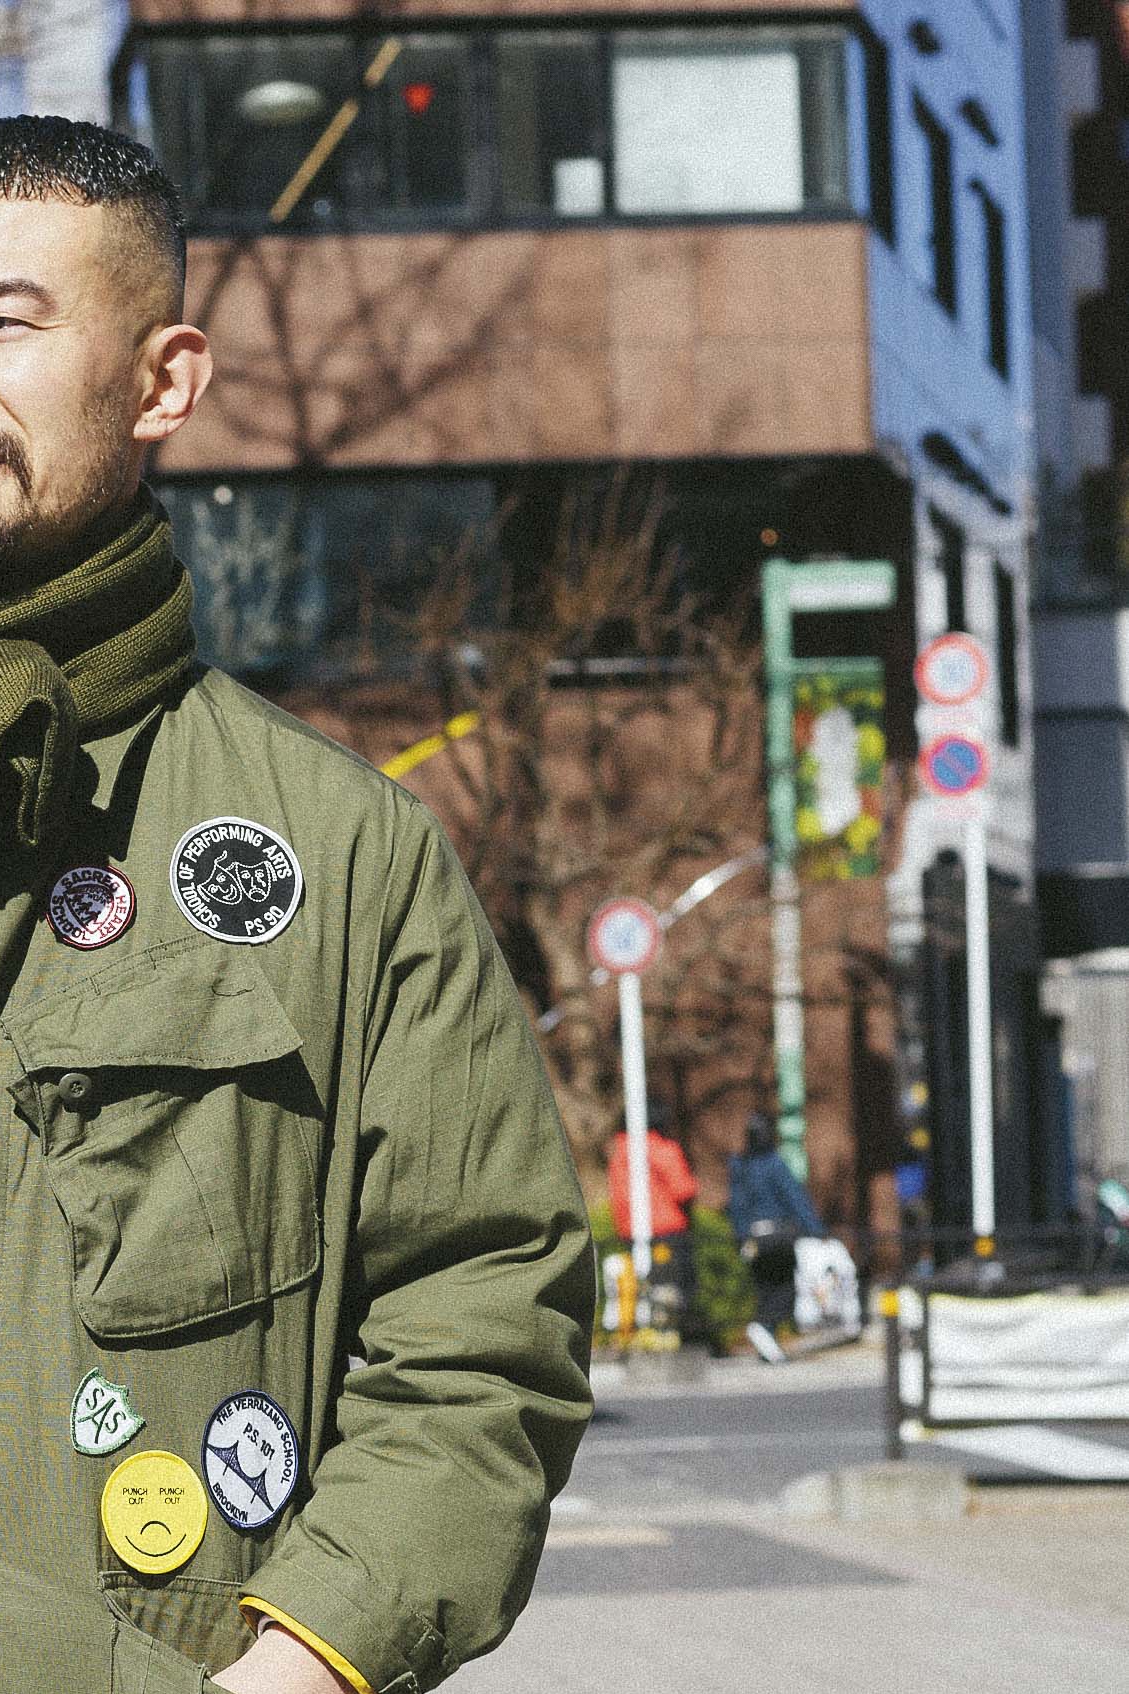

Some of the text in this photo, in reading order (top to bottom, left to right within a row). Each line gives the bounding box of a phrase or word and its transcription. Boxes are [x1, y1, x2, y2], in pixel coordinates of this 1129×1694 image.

[61, 870, 120, 893] SACRED
[178, 825, 292, 929] SCHOOL OF PERFORMING ARTS
[52, 895, 90, 940] SCHOOL
[99, 895, 127, 939] HEART
[244, 905, 284, 935] PS 90
[216, 1398, 294, 1484] THE VERRAZANO SCHOOL
[242, 1422, 276, 1460] P.S. 101
[122, 1487, 148, 1496] PUNCH
[128, 1497, 144, 1505] OUT
[159, 1487, 185, 1496] PUNCH
[164, 1497, 181, 1505] OUT
[212, 1482, 249, 1522] BROOKLYN
